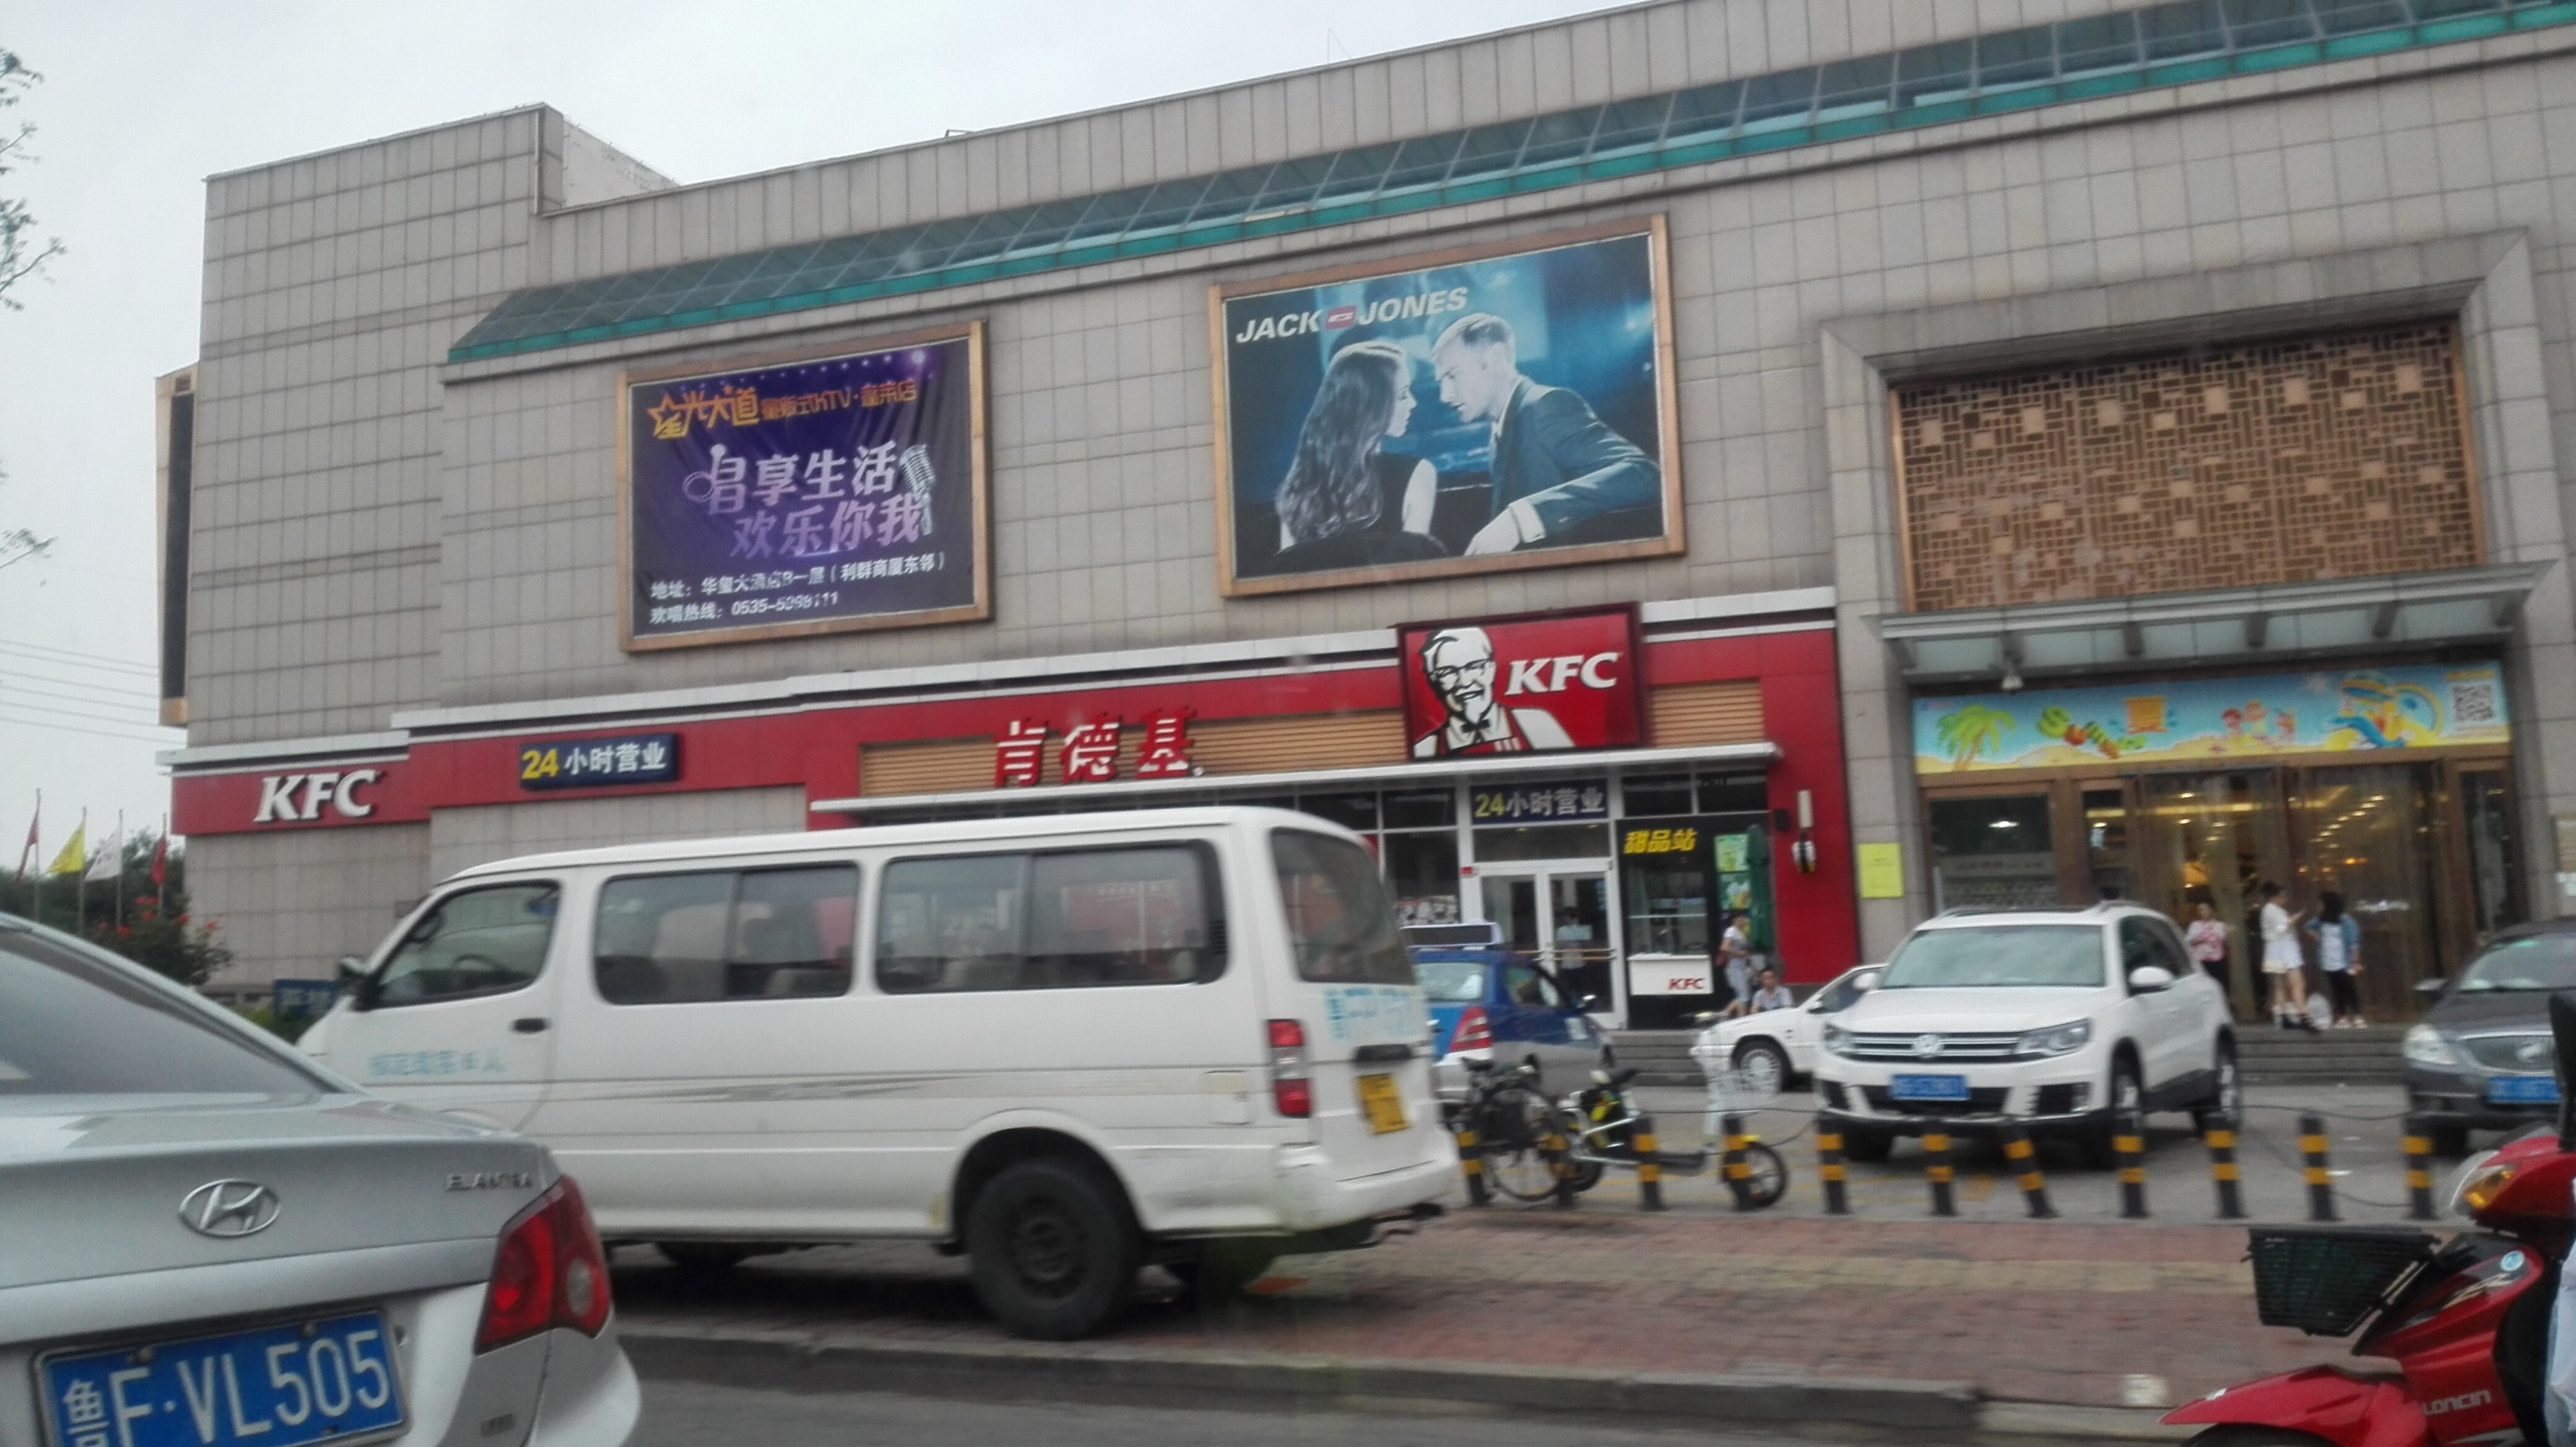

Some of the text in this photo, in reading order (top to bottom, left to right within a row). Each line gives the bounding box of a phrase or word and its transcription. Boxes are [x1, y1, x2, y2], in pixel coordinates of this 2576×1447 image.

[1235, 286, 1469, 344] JACK JONES
[647, 385, 760, 439] 星光大道
[730, 492, 923, 559] 欢乐你我
[1503, 652, 1621, 696] KFC
[993, 708, 1195, 789] 肯德基
[253, 769, 377, 822] KFC
[1474, 786, 1605, 818] 24小时营业
[1624, 828, 1699, 854] 甜品站
[1668, 977, 1705, 990] KFC
